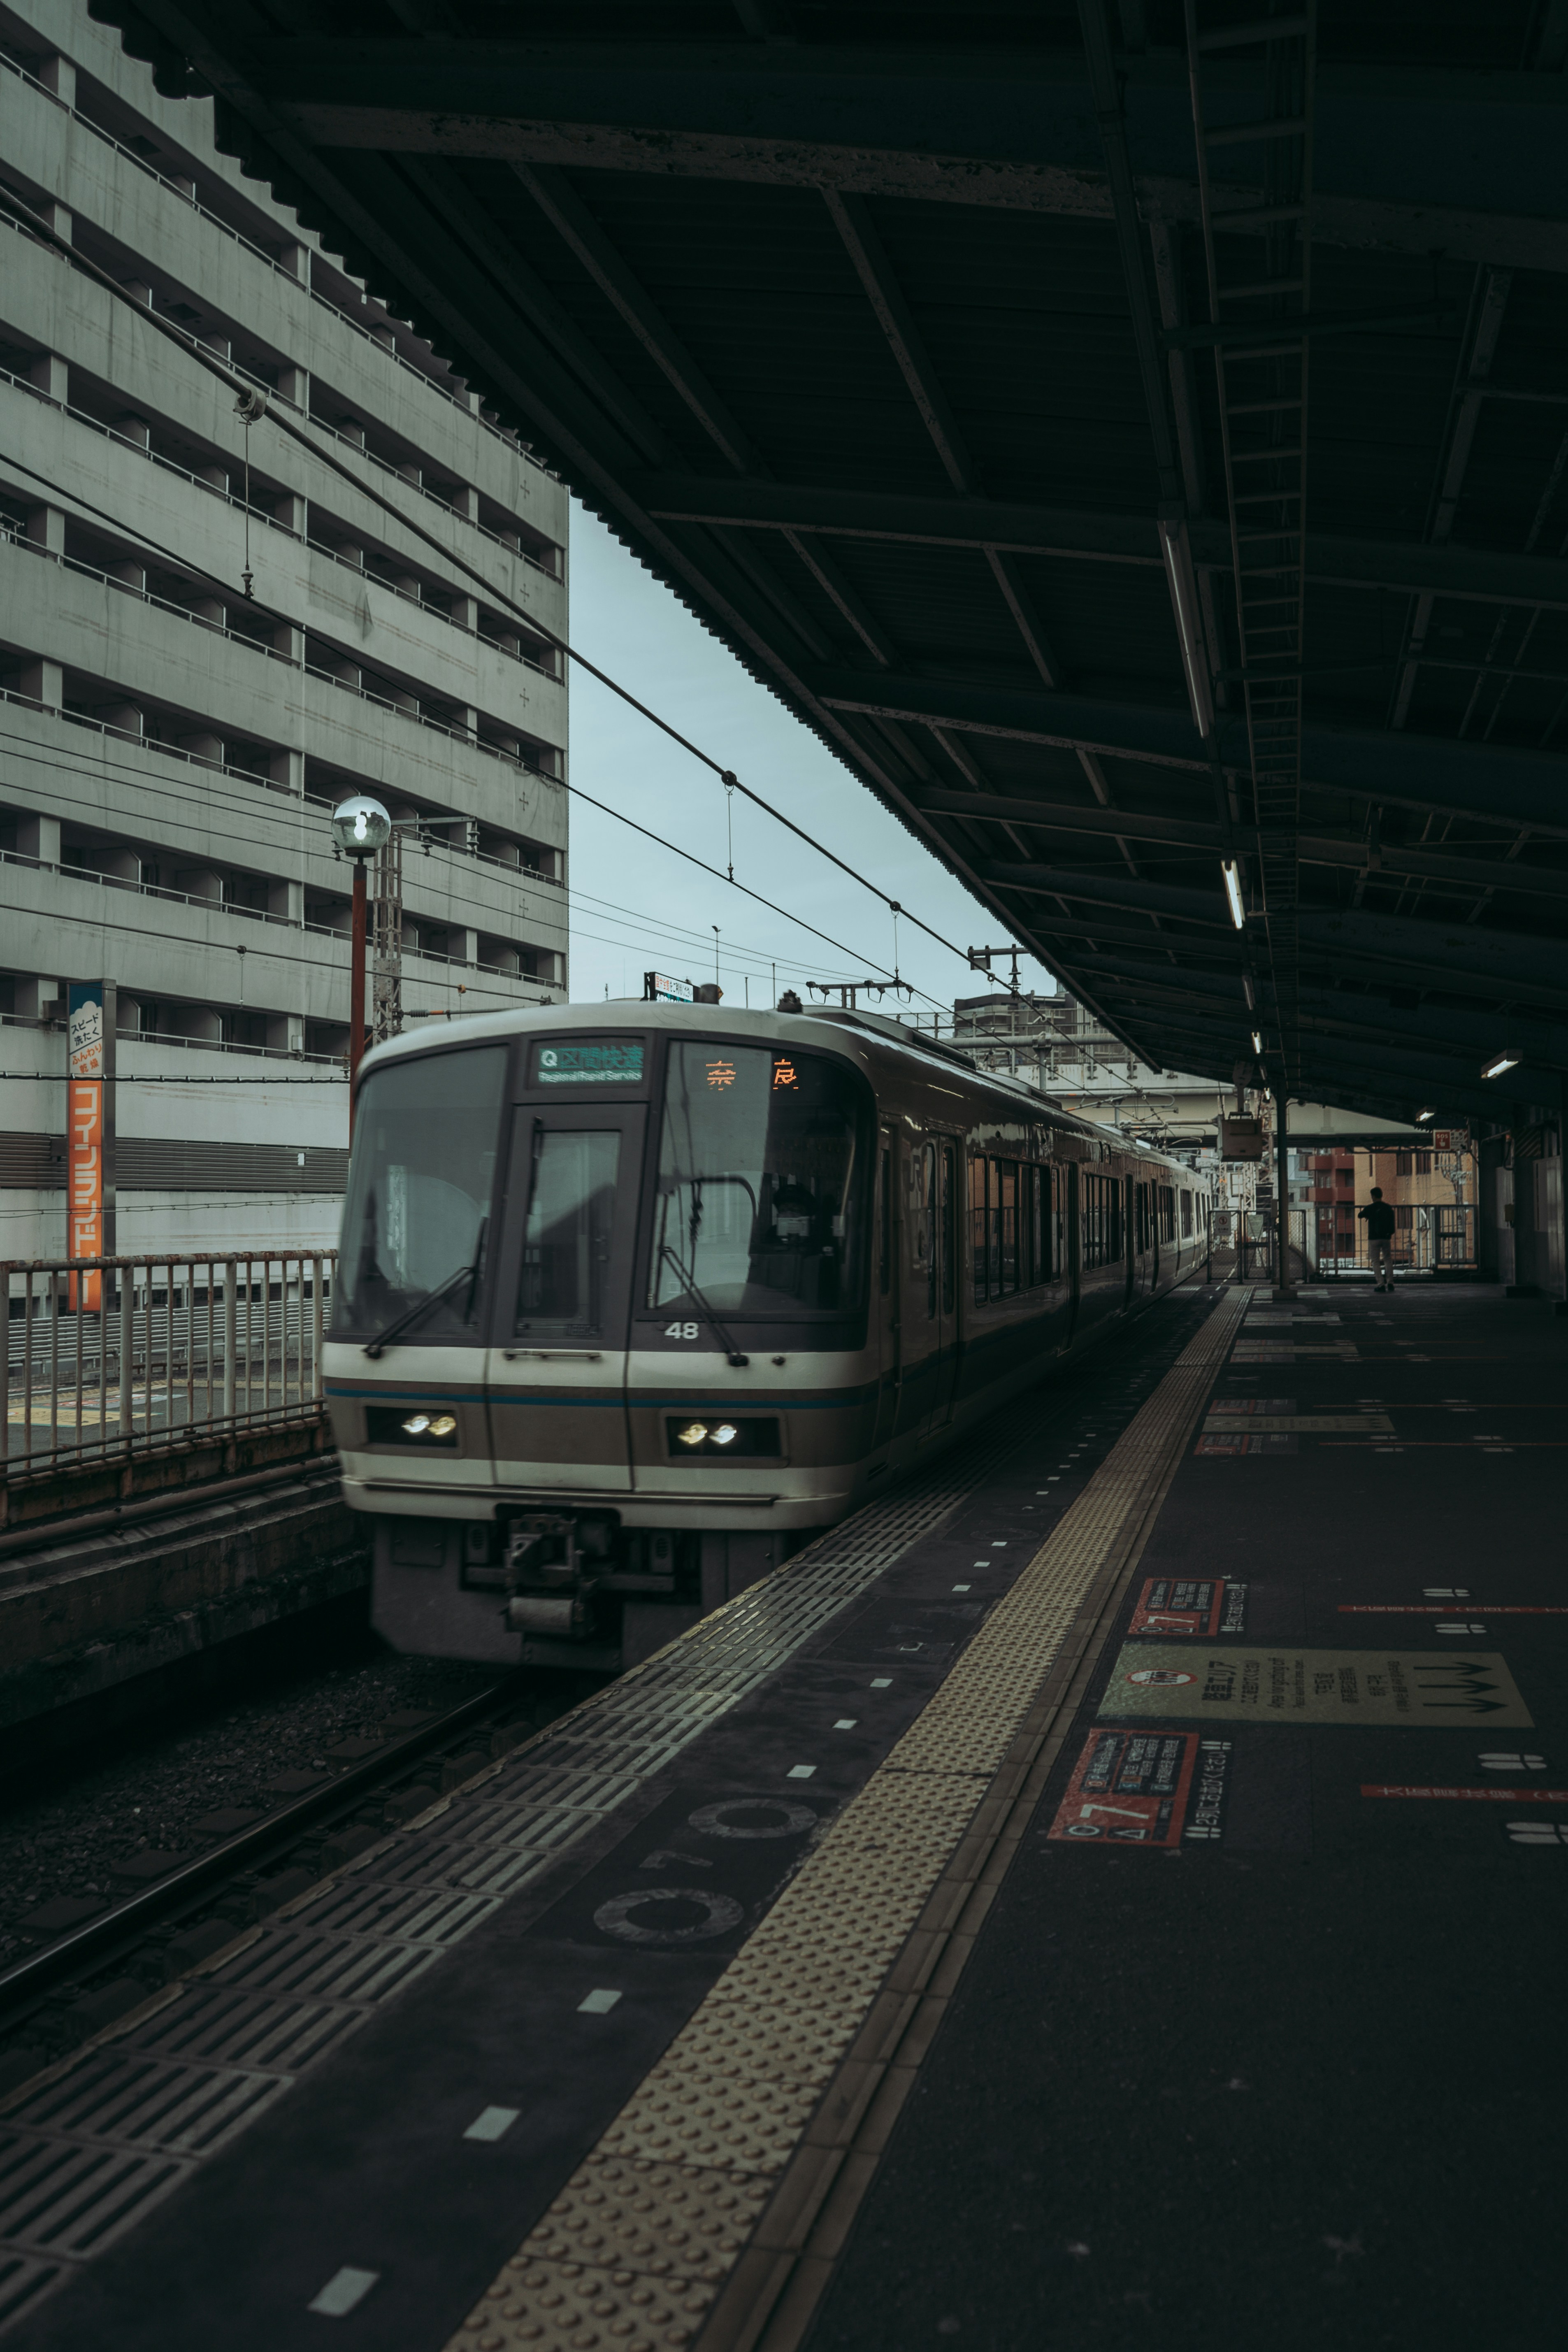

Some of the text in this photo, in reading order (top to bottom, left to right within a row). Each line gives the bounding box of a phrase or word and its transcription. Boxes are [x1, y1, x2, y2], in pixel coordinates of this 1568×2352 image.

[71, 1013, 99, 1035] スピード
[74, 1027, 100, 1046] 洗たく
[72, 1043, 102, 1065] ふんわり
[540, 1045, 644, 1069] Q 区間快速
[79, 1058, 100, 1074] 乾燥
[705, 1059, 799, 1091] 奈良
[664, 1322, 699, 1339] 48
[1268, 1657, 1285, 1666] off
[1268, 1666, 1289, 1685] getting
[1267, 1695, 1285, 1708] Area
[1195, 1751, 1227, 1825] 2列にお並びください
[1378, 1787, 1517, 1799] 大阪環状線
[1080, 1804, 1150, 1819] 7
